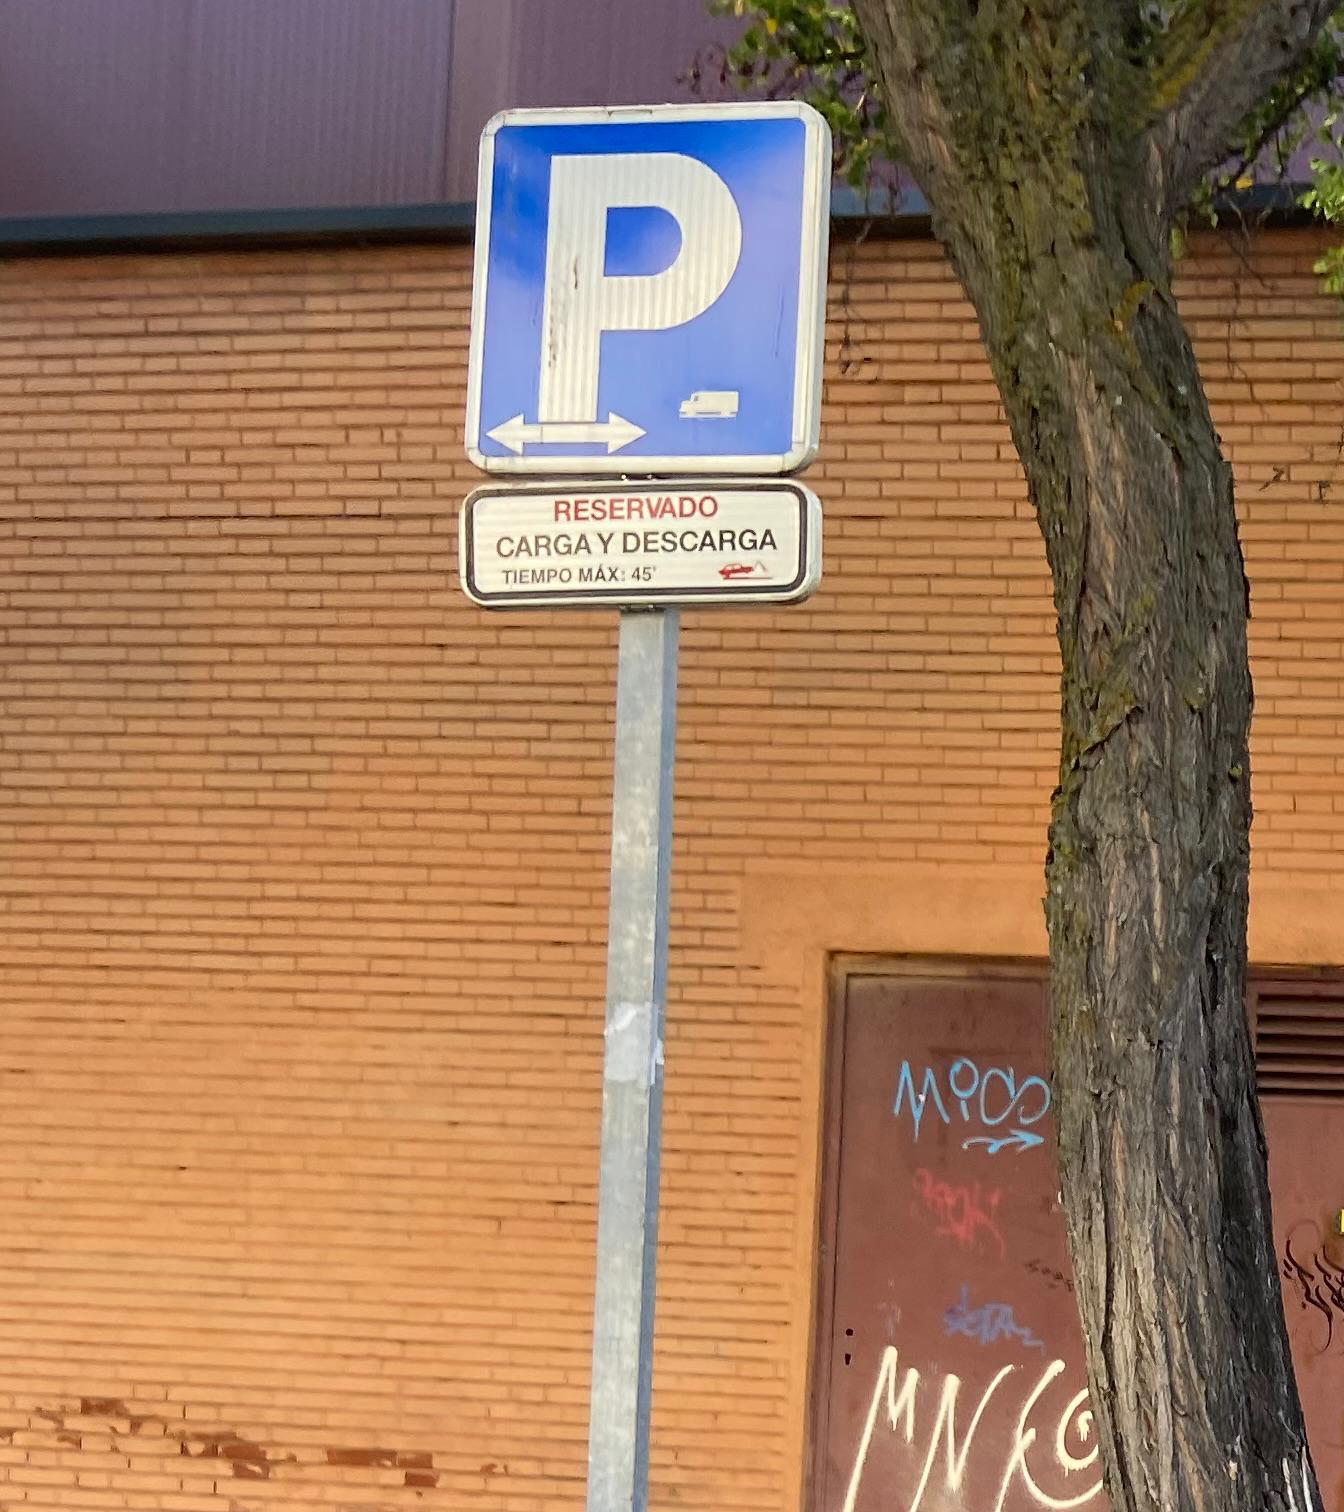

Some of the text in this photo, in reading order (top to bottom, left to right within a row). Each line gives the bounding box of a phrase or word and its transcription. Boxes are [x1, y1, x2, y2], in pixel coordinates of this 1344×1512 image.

[537, 152, 742, 423] P
[554, 496, 718, 522] RESERVADO
[496, 528, 778, 558] CARGA Y DESCARGA
[502, 567, 572, 585] TIEMPO
[578, 563, 626, 583] MÁX:
